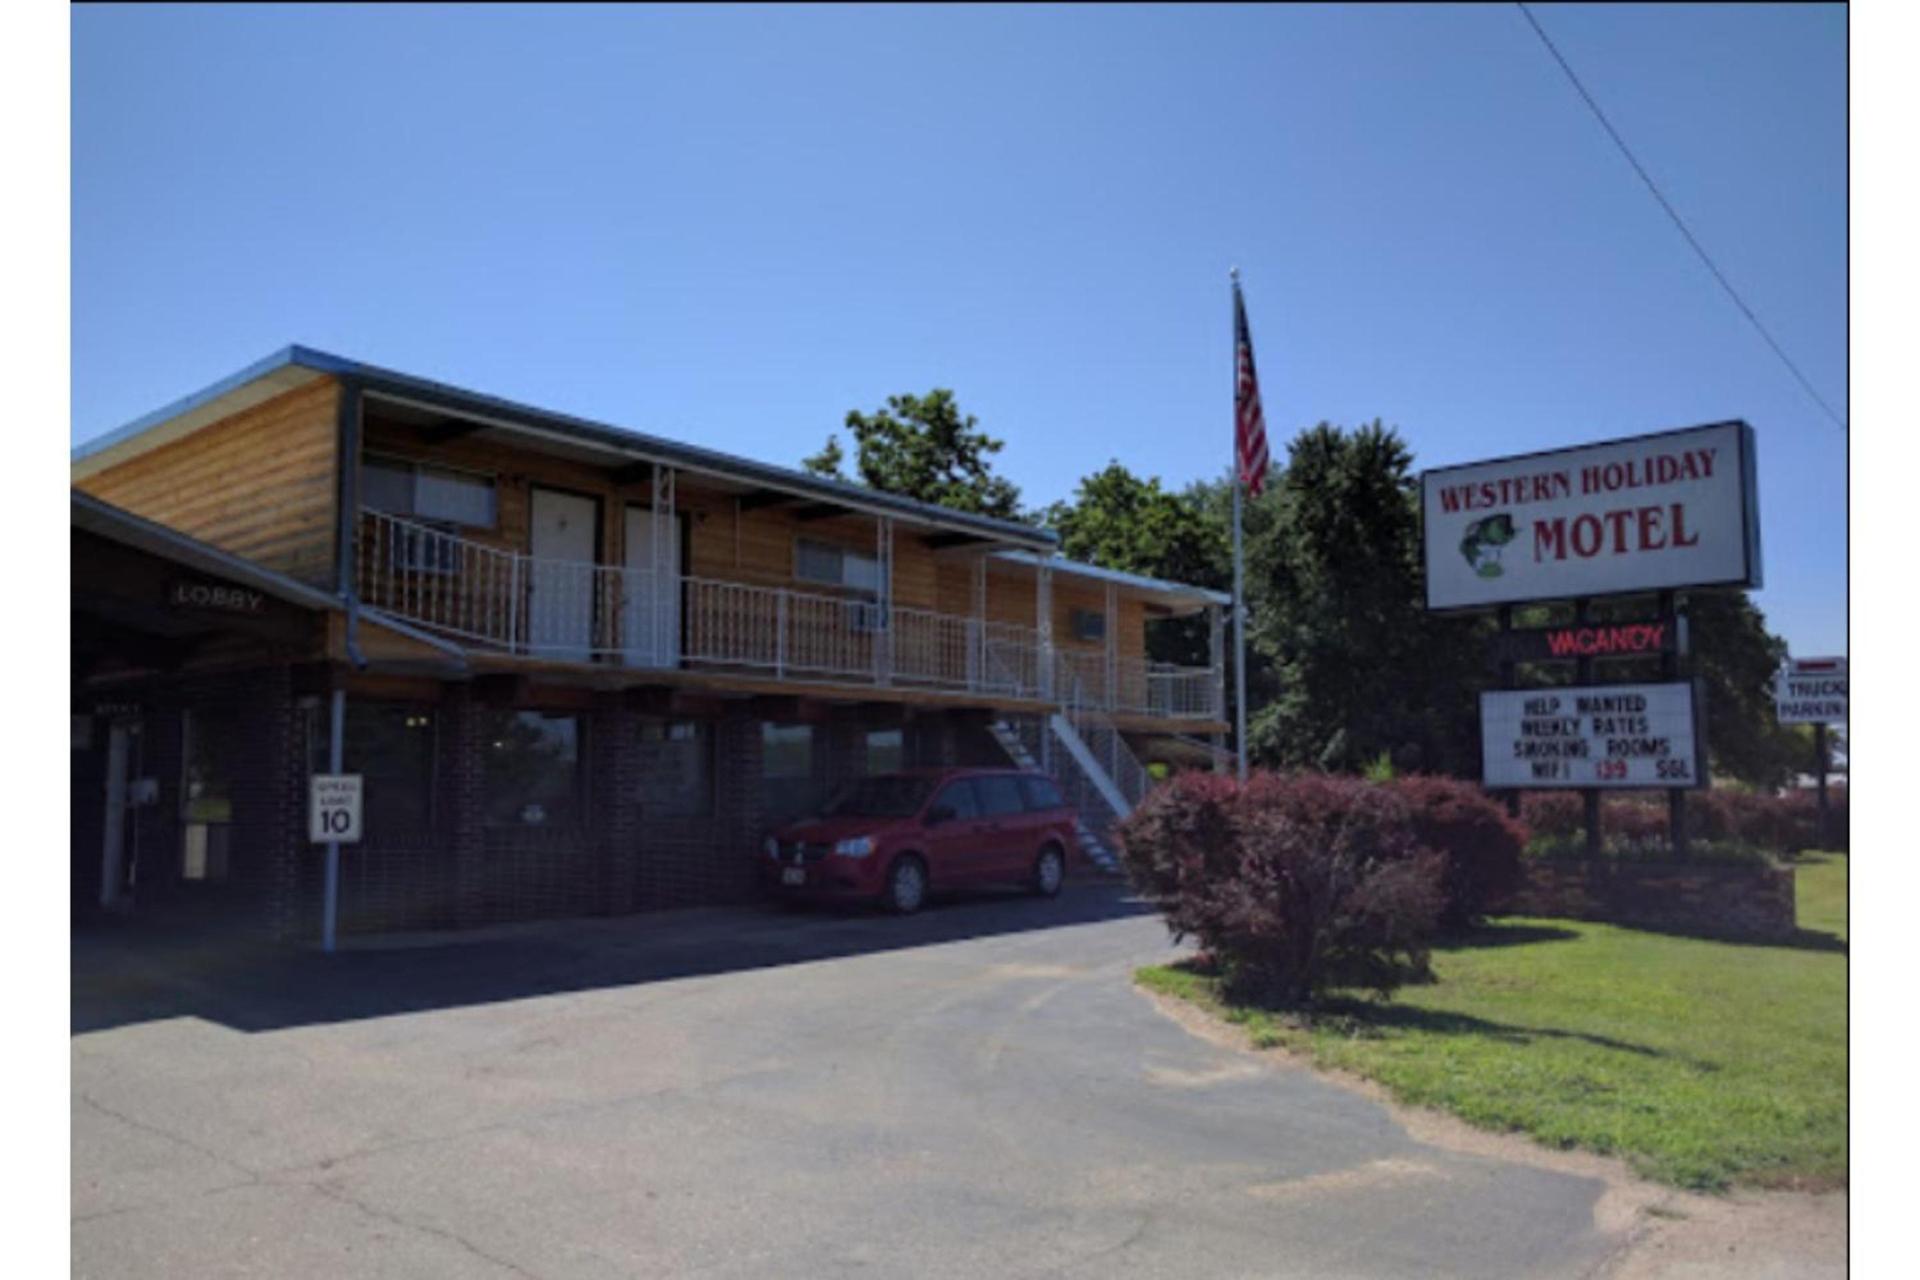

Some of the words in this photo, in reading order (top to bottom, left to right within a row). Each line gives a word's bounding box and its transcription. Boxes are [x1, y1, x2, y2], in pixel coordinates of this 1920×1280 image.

[1440, 470, 1570, 513] WESTERN
[1582, 448, 1717, 495] HOLIDAY
[1533, 503, 1698, 563] MOTEL
[177, 585, 264, 611] LOBBY
[1524, 696, 1561, 715] HELP
[1576, 693, 1647, 714] WANTED
[1521, 717, 1581, 737] WEEKLY
[1593, 715, 1649, 735] RATES
[1513, 738, 1589, 758] SMOKING
[1607, 736, 1671, 757] ROOMS
[321, 808, 350, 834] 10
